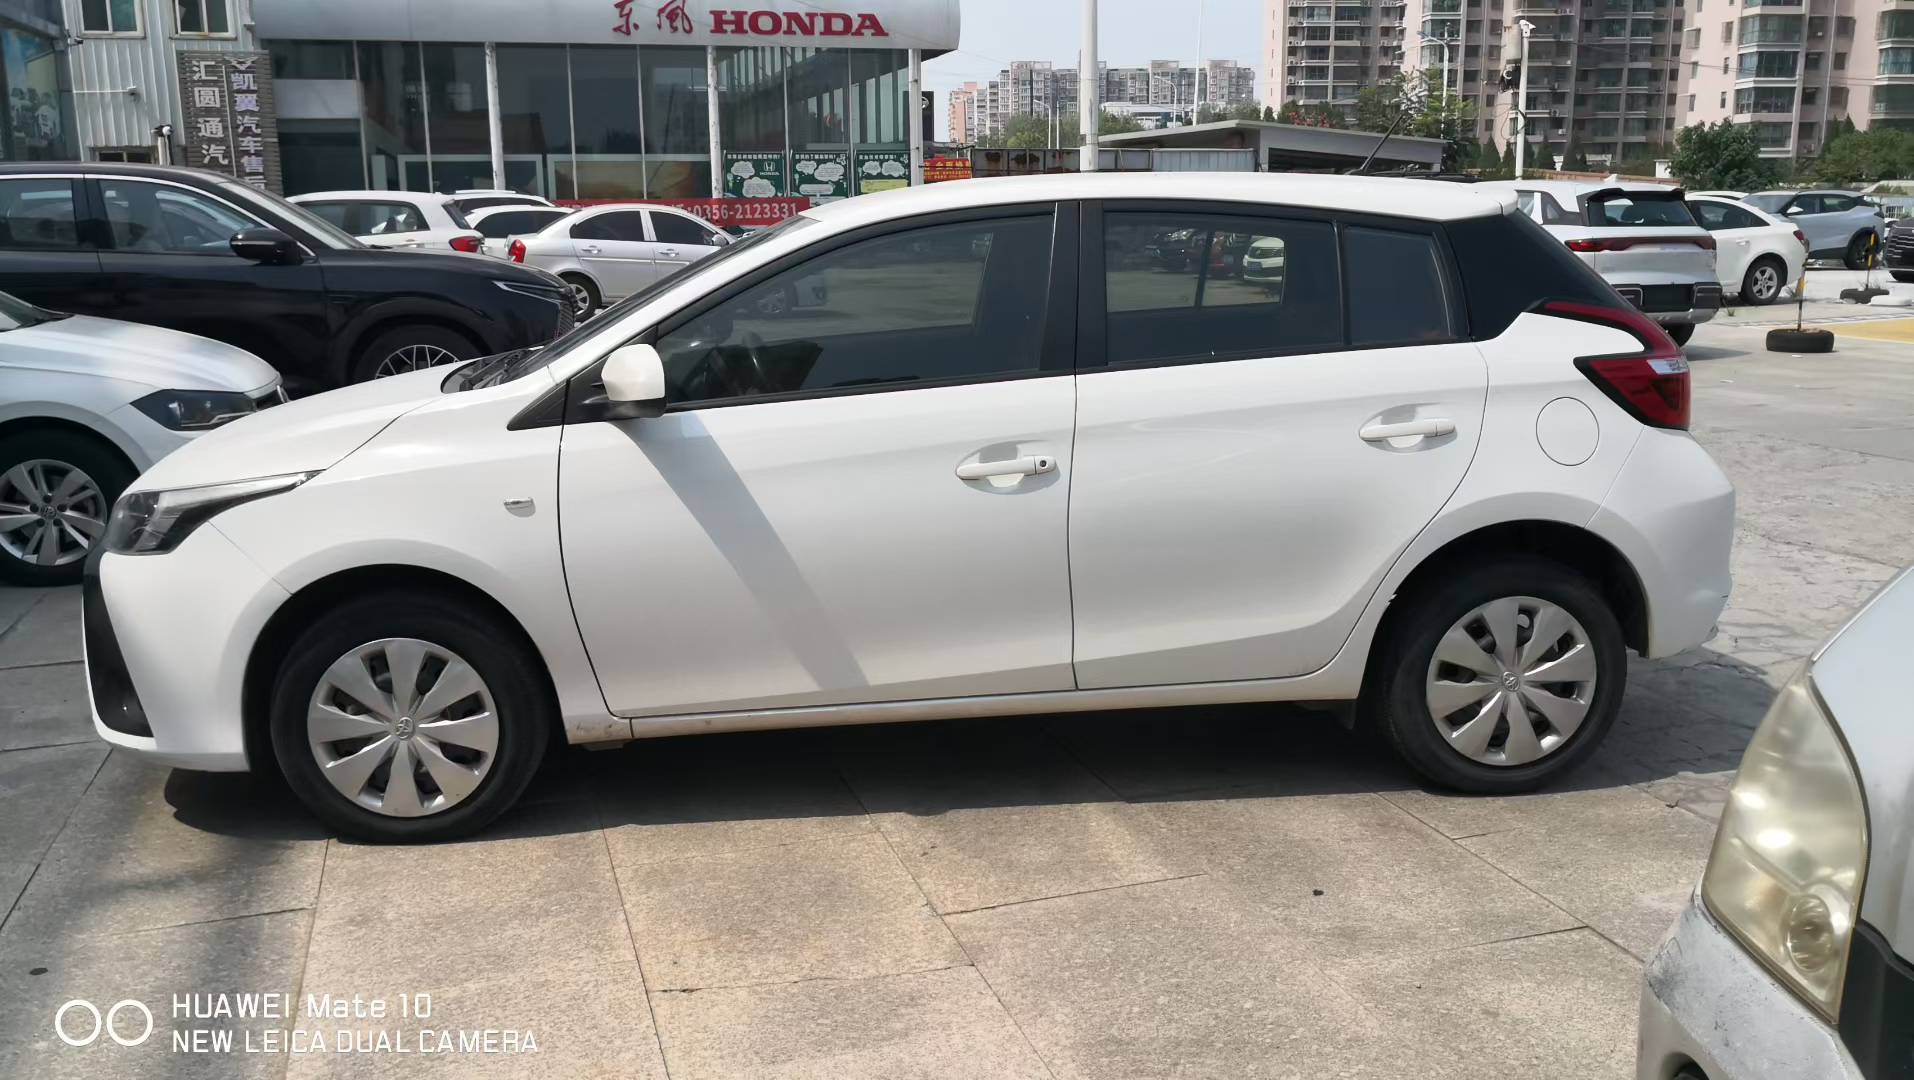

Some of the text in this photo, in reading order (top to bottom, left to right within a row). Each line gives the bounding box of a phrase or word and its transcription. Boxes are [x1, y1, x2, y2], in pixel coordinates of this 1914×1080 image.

[612, 0, 888, 36] 东风 HONDA
[192, 60, 229, 165] 汇圆通汽
